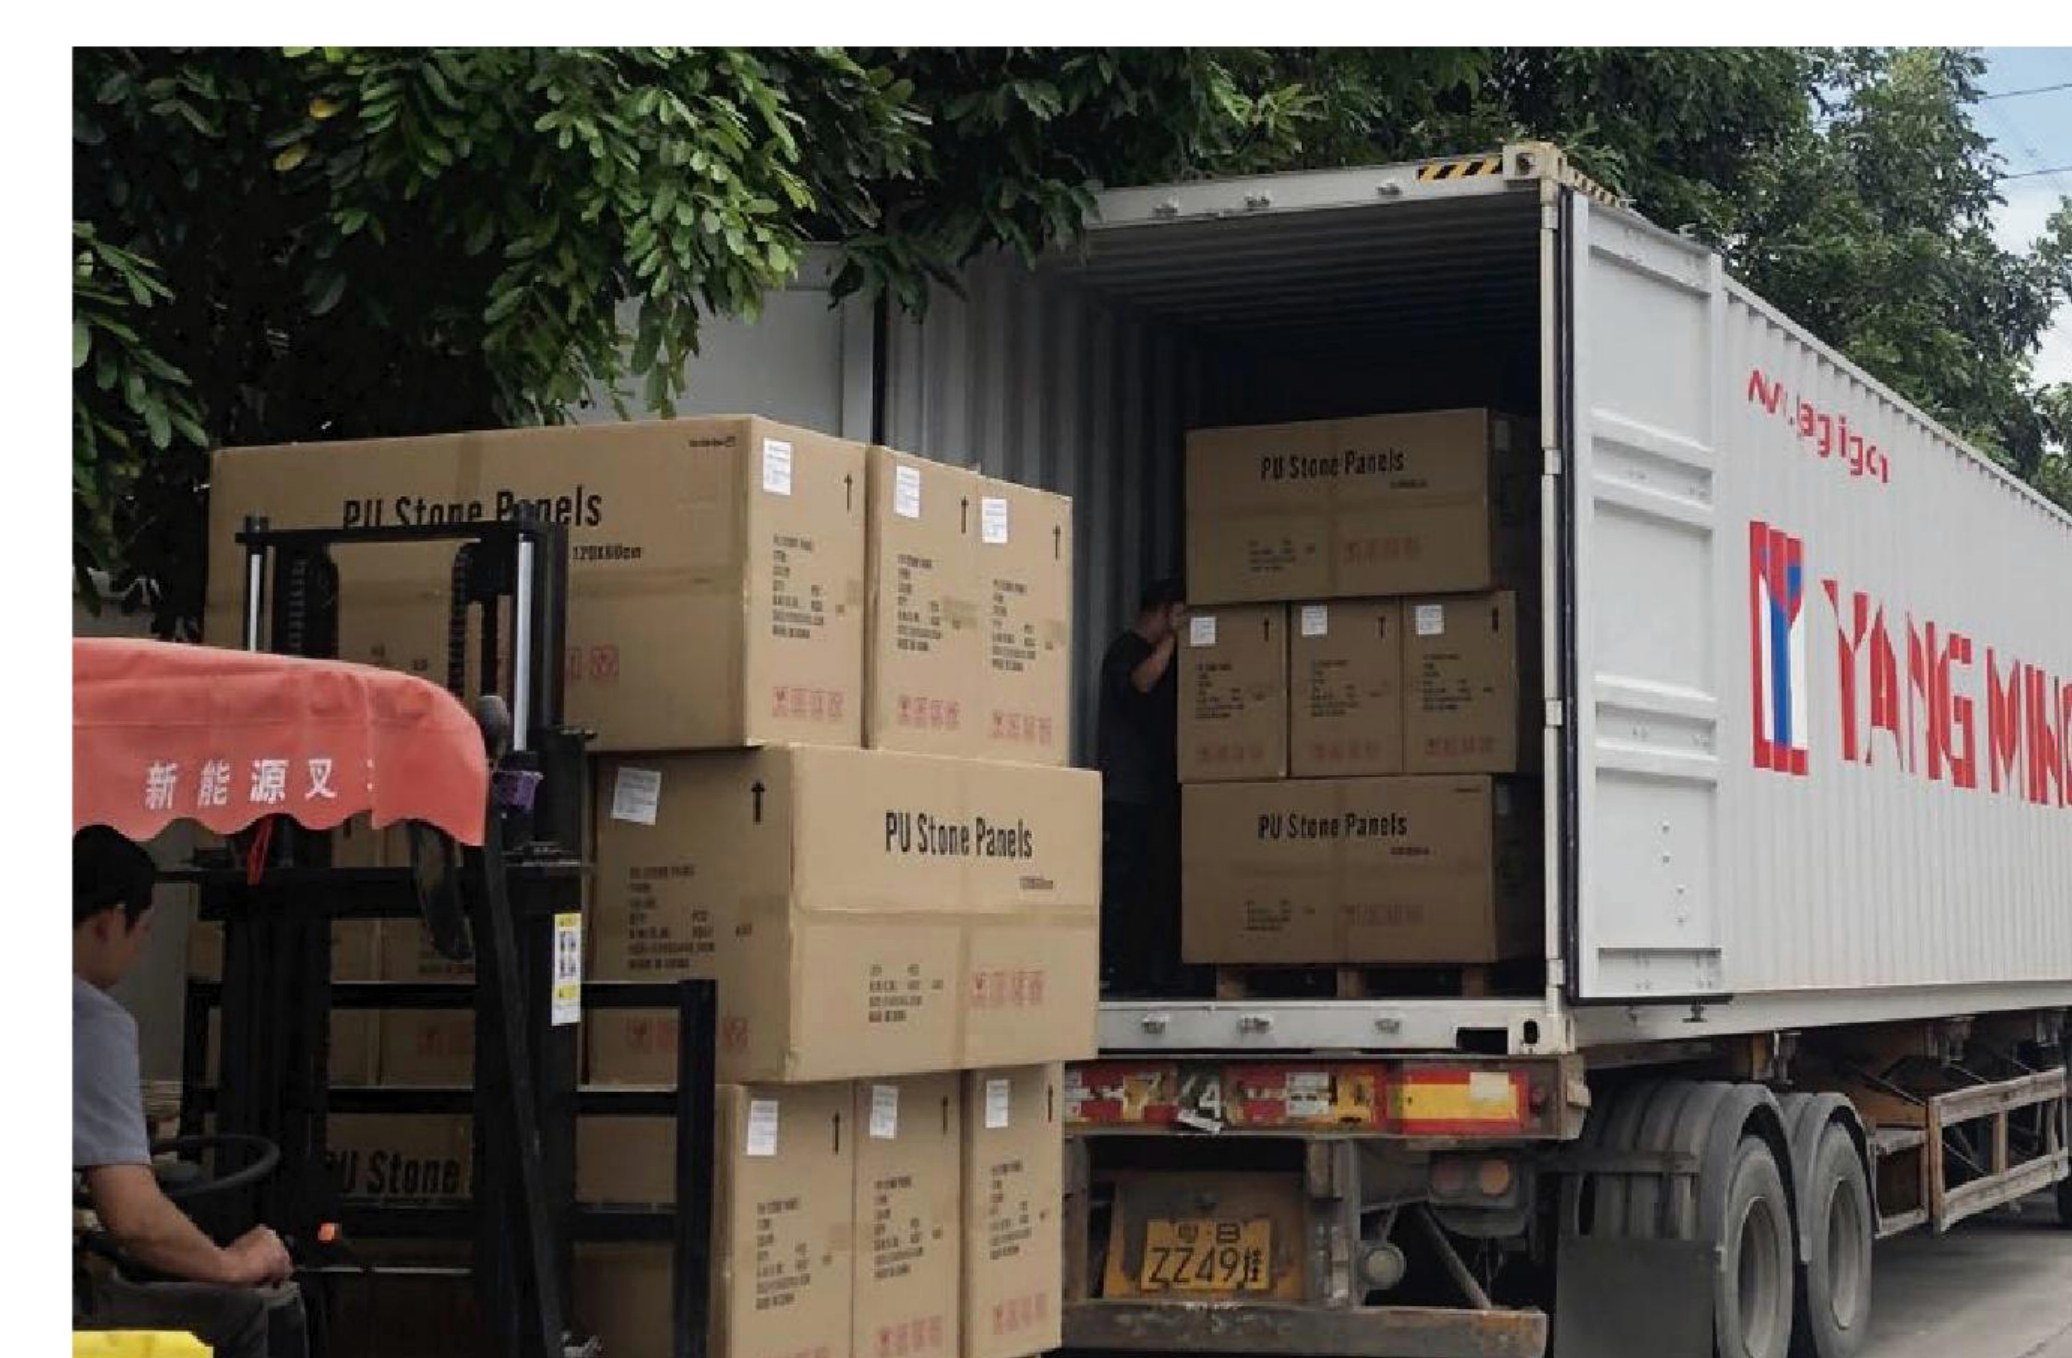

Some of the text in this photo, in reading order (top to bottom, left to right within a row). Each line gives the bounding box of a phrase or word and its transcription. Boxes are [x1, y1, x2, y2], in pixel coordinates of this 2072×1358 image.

[1261, 448, 1404, 480] PU Stone Panels
[395, 496, 482, 525] Stone
[497, 484, 602, 526] Pnels
[1822, 579, 1977, 789] YANG
[145, 758, 374, 809] 新能源叉
[886, 812, 1033, 858] PU Stone Panels
[1258, 813, 1407, 839] PU Stone Panels
